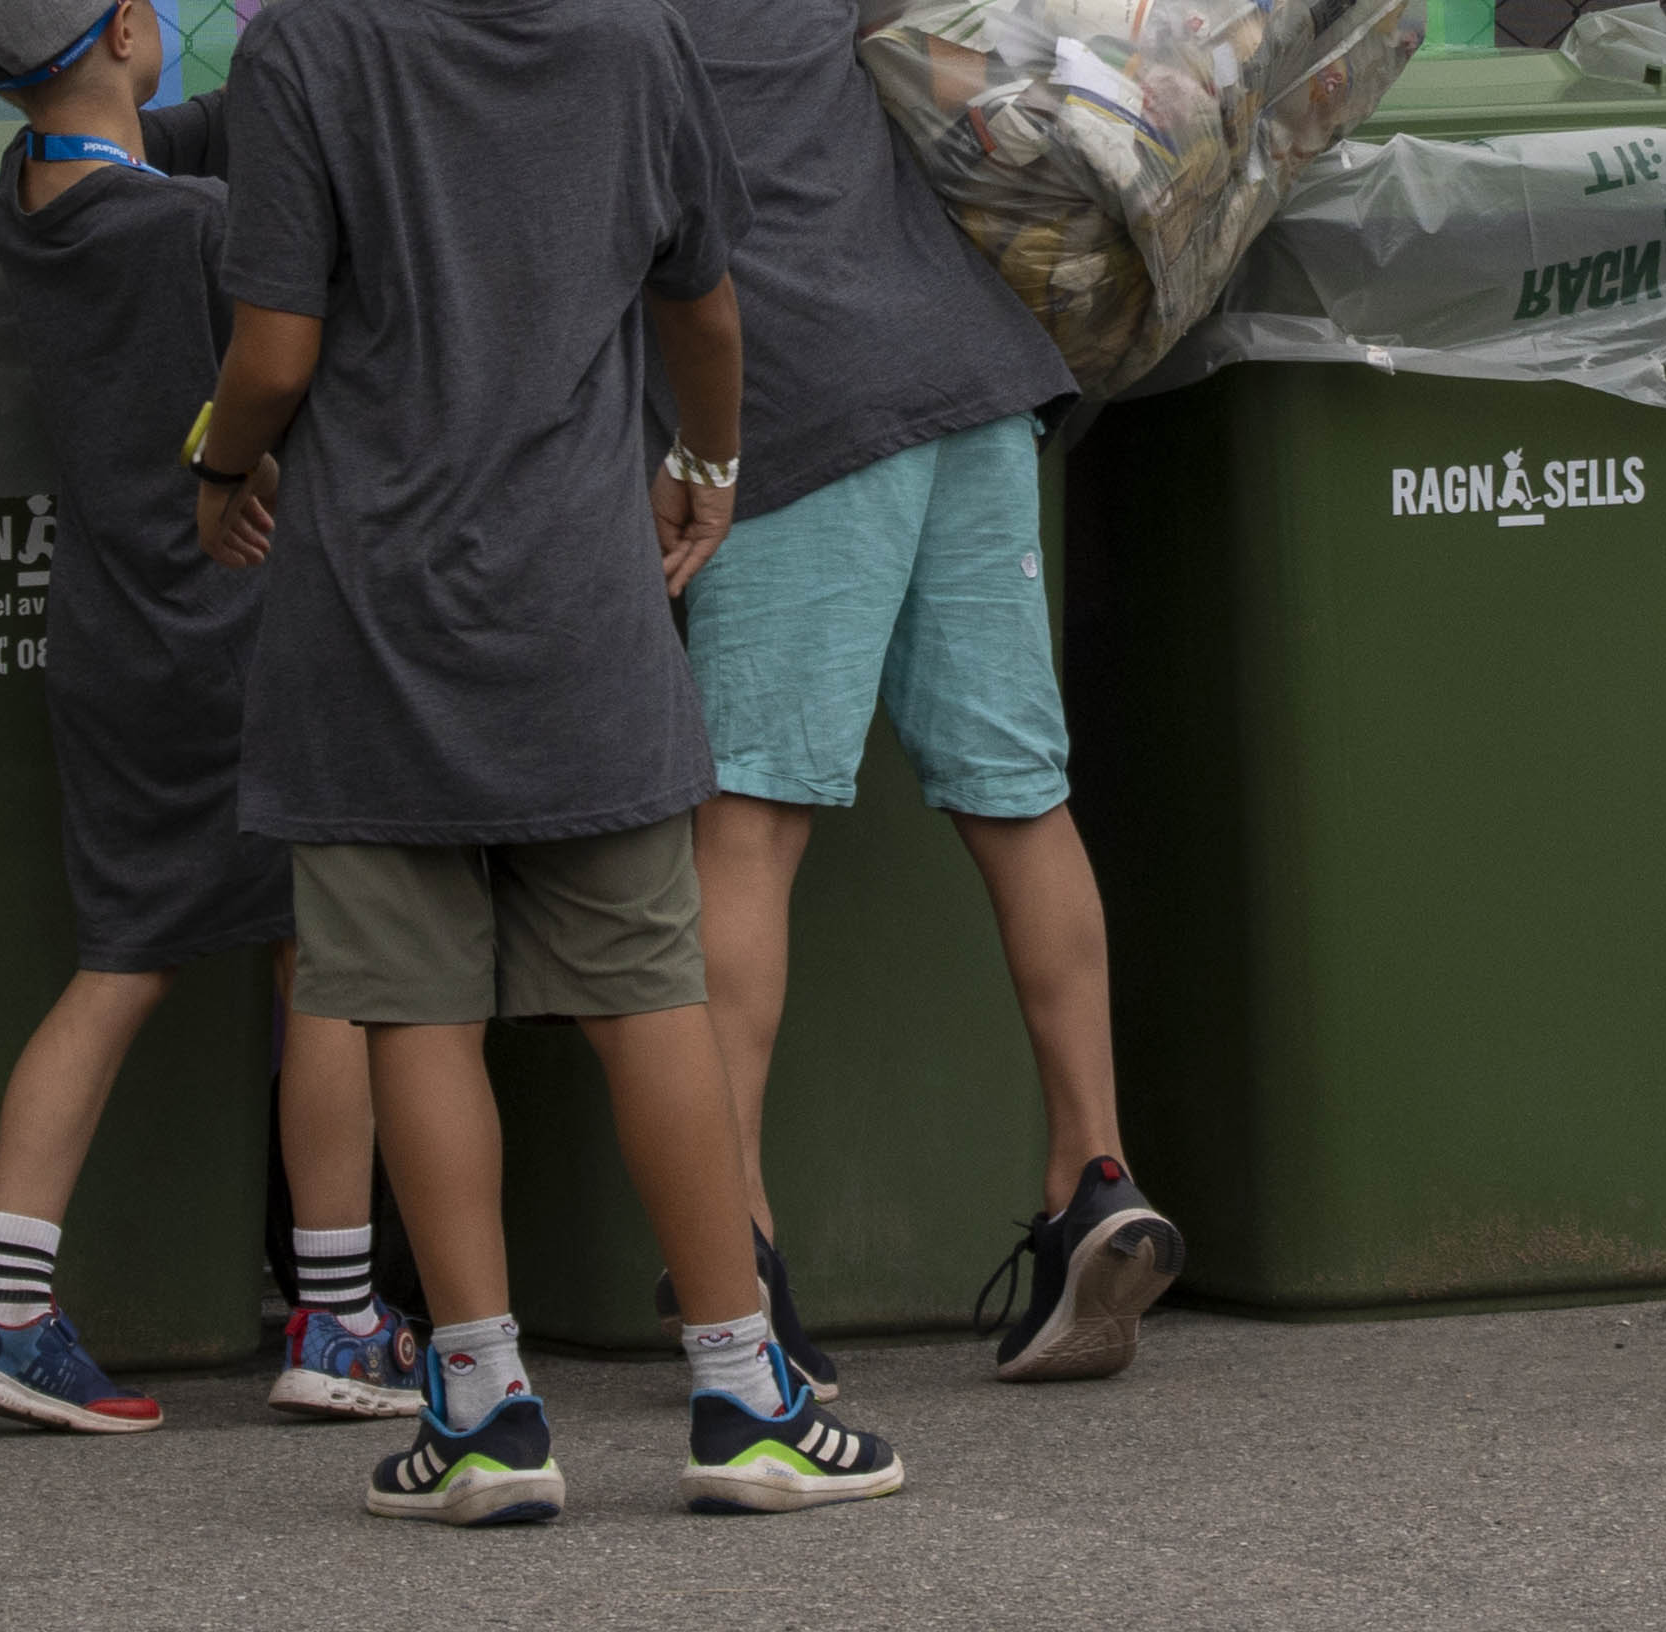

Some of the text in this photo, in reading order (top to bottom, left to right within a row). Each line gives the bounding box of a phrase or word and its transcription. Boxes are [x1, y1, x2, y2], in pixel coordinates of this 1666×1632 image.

[1392, 456, 1646, 516] RAGN SELLS
[18, 597, 45, 615] av
